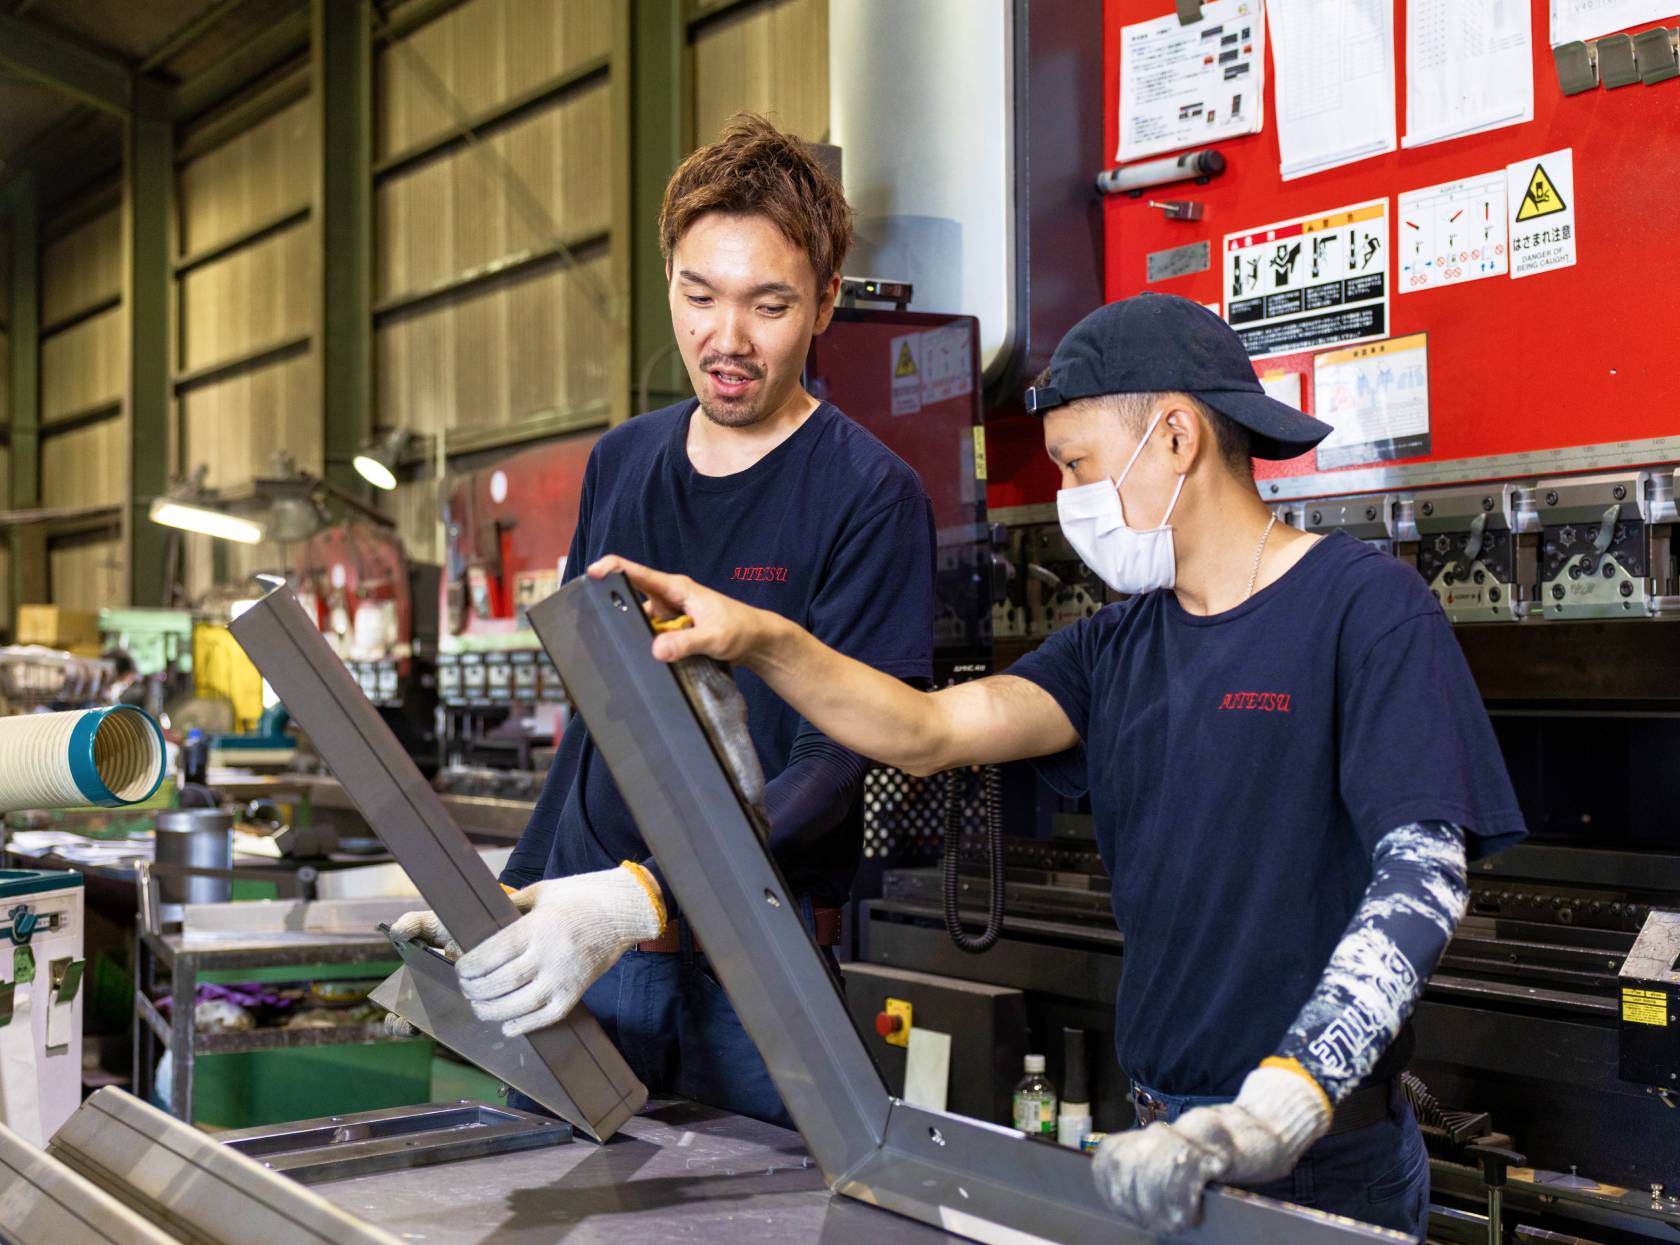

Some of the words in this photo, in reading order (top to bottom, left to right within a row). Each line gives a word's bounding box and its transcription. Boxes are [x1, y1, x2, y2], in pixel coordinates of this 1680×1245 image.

[1513, 225, 1571, 251] はさまれ注意
[1517, 261, 1539, 272] BEING
[1540, 254, 1569, 267] CAUGHT
[1522, 250, 1551, 263] DANGER
[1553, 247, 1563, 255] OF
[1217, 691, 1292, 712] AITETSU
